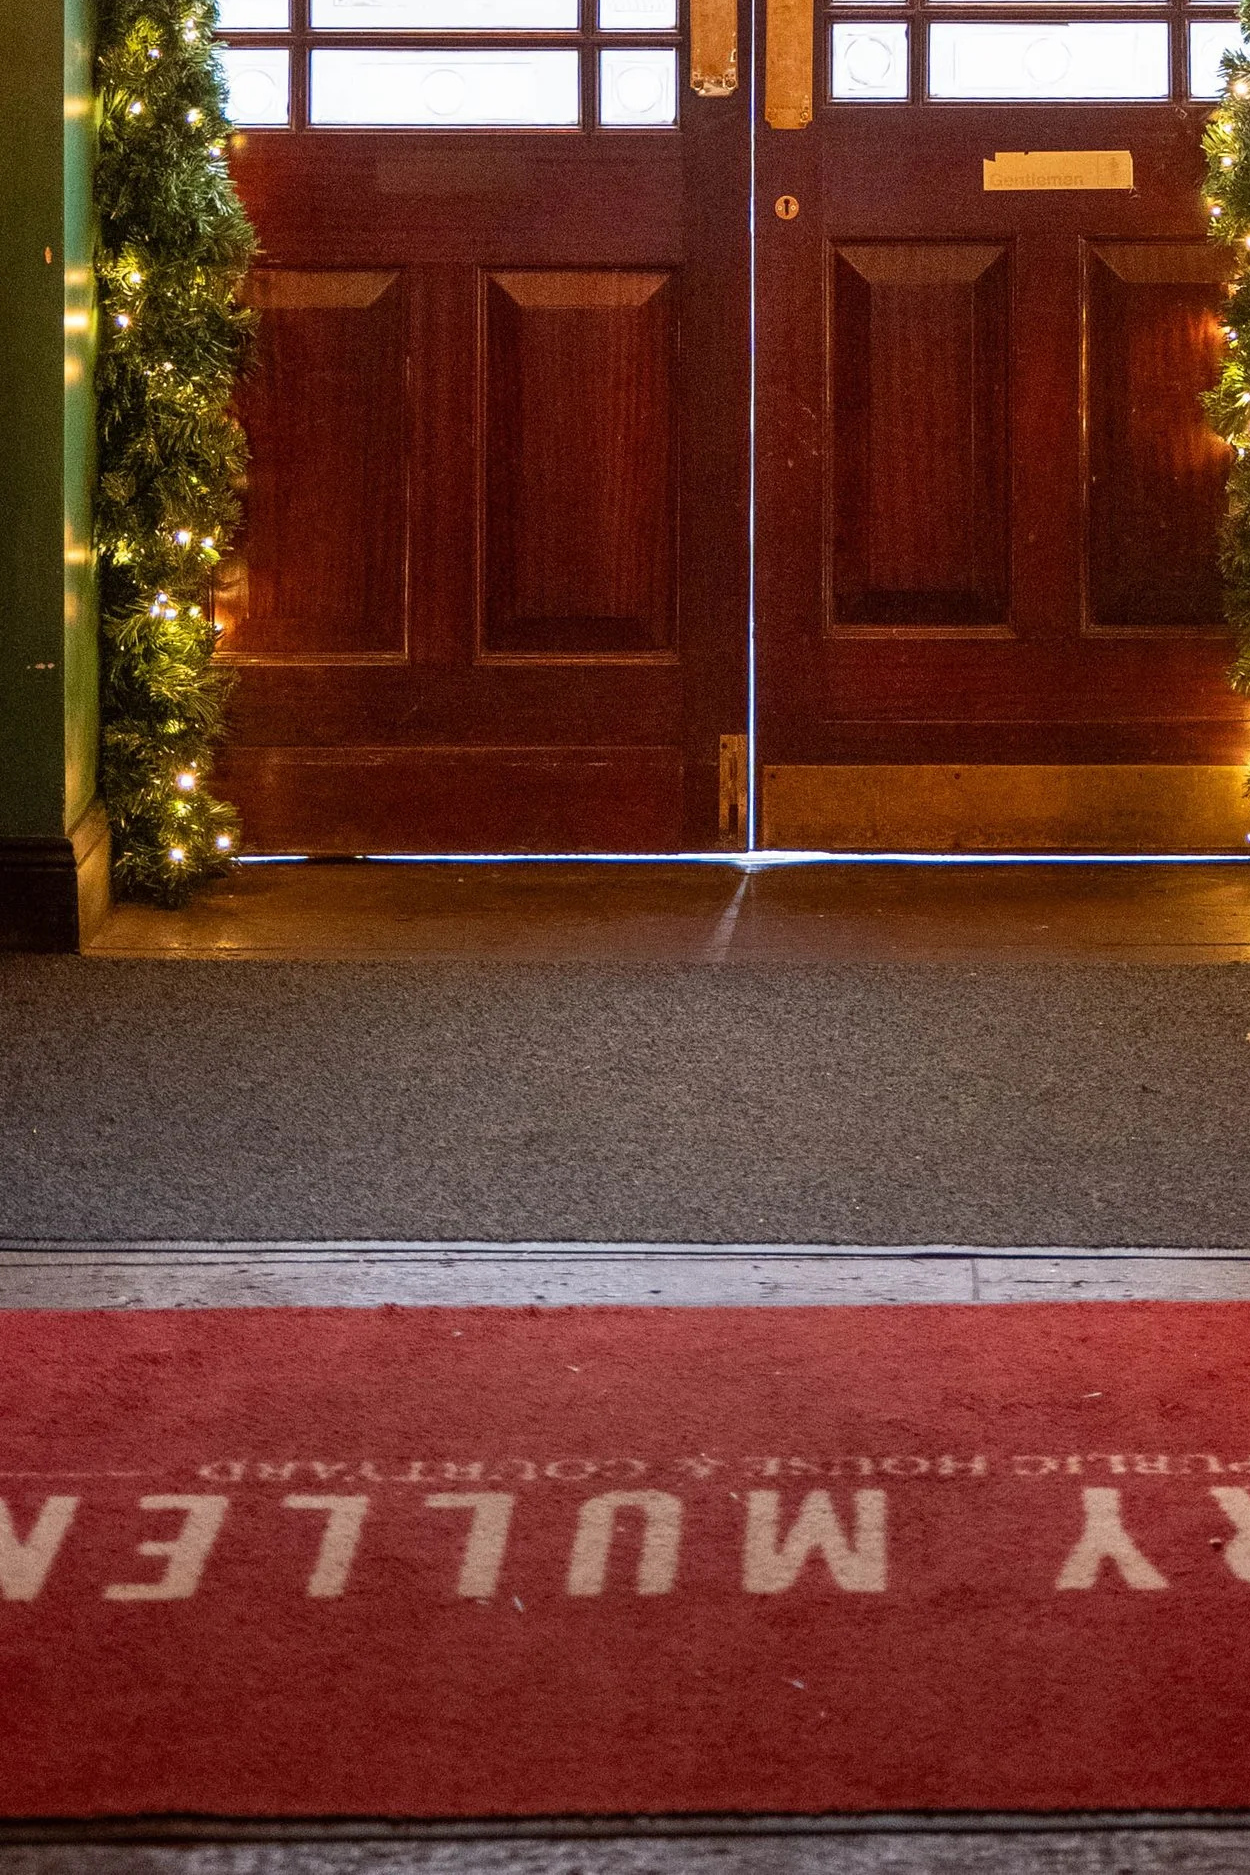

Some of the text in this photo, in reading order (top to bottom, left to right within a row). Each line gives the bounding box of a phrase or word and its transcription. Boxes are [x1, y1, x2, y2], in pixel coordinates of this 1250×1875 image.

[989, 173, 1084, 187] Gentlemen
[200, 1458, 648, 1482] COURTYARD
[744, 1454, 987, 1478] HOUSE
